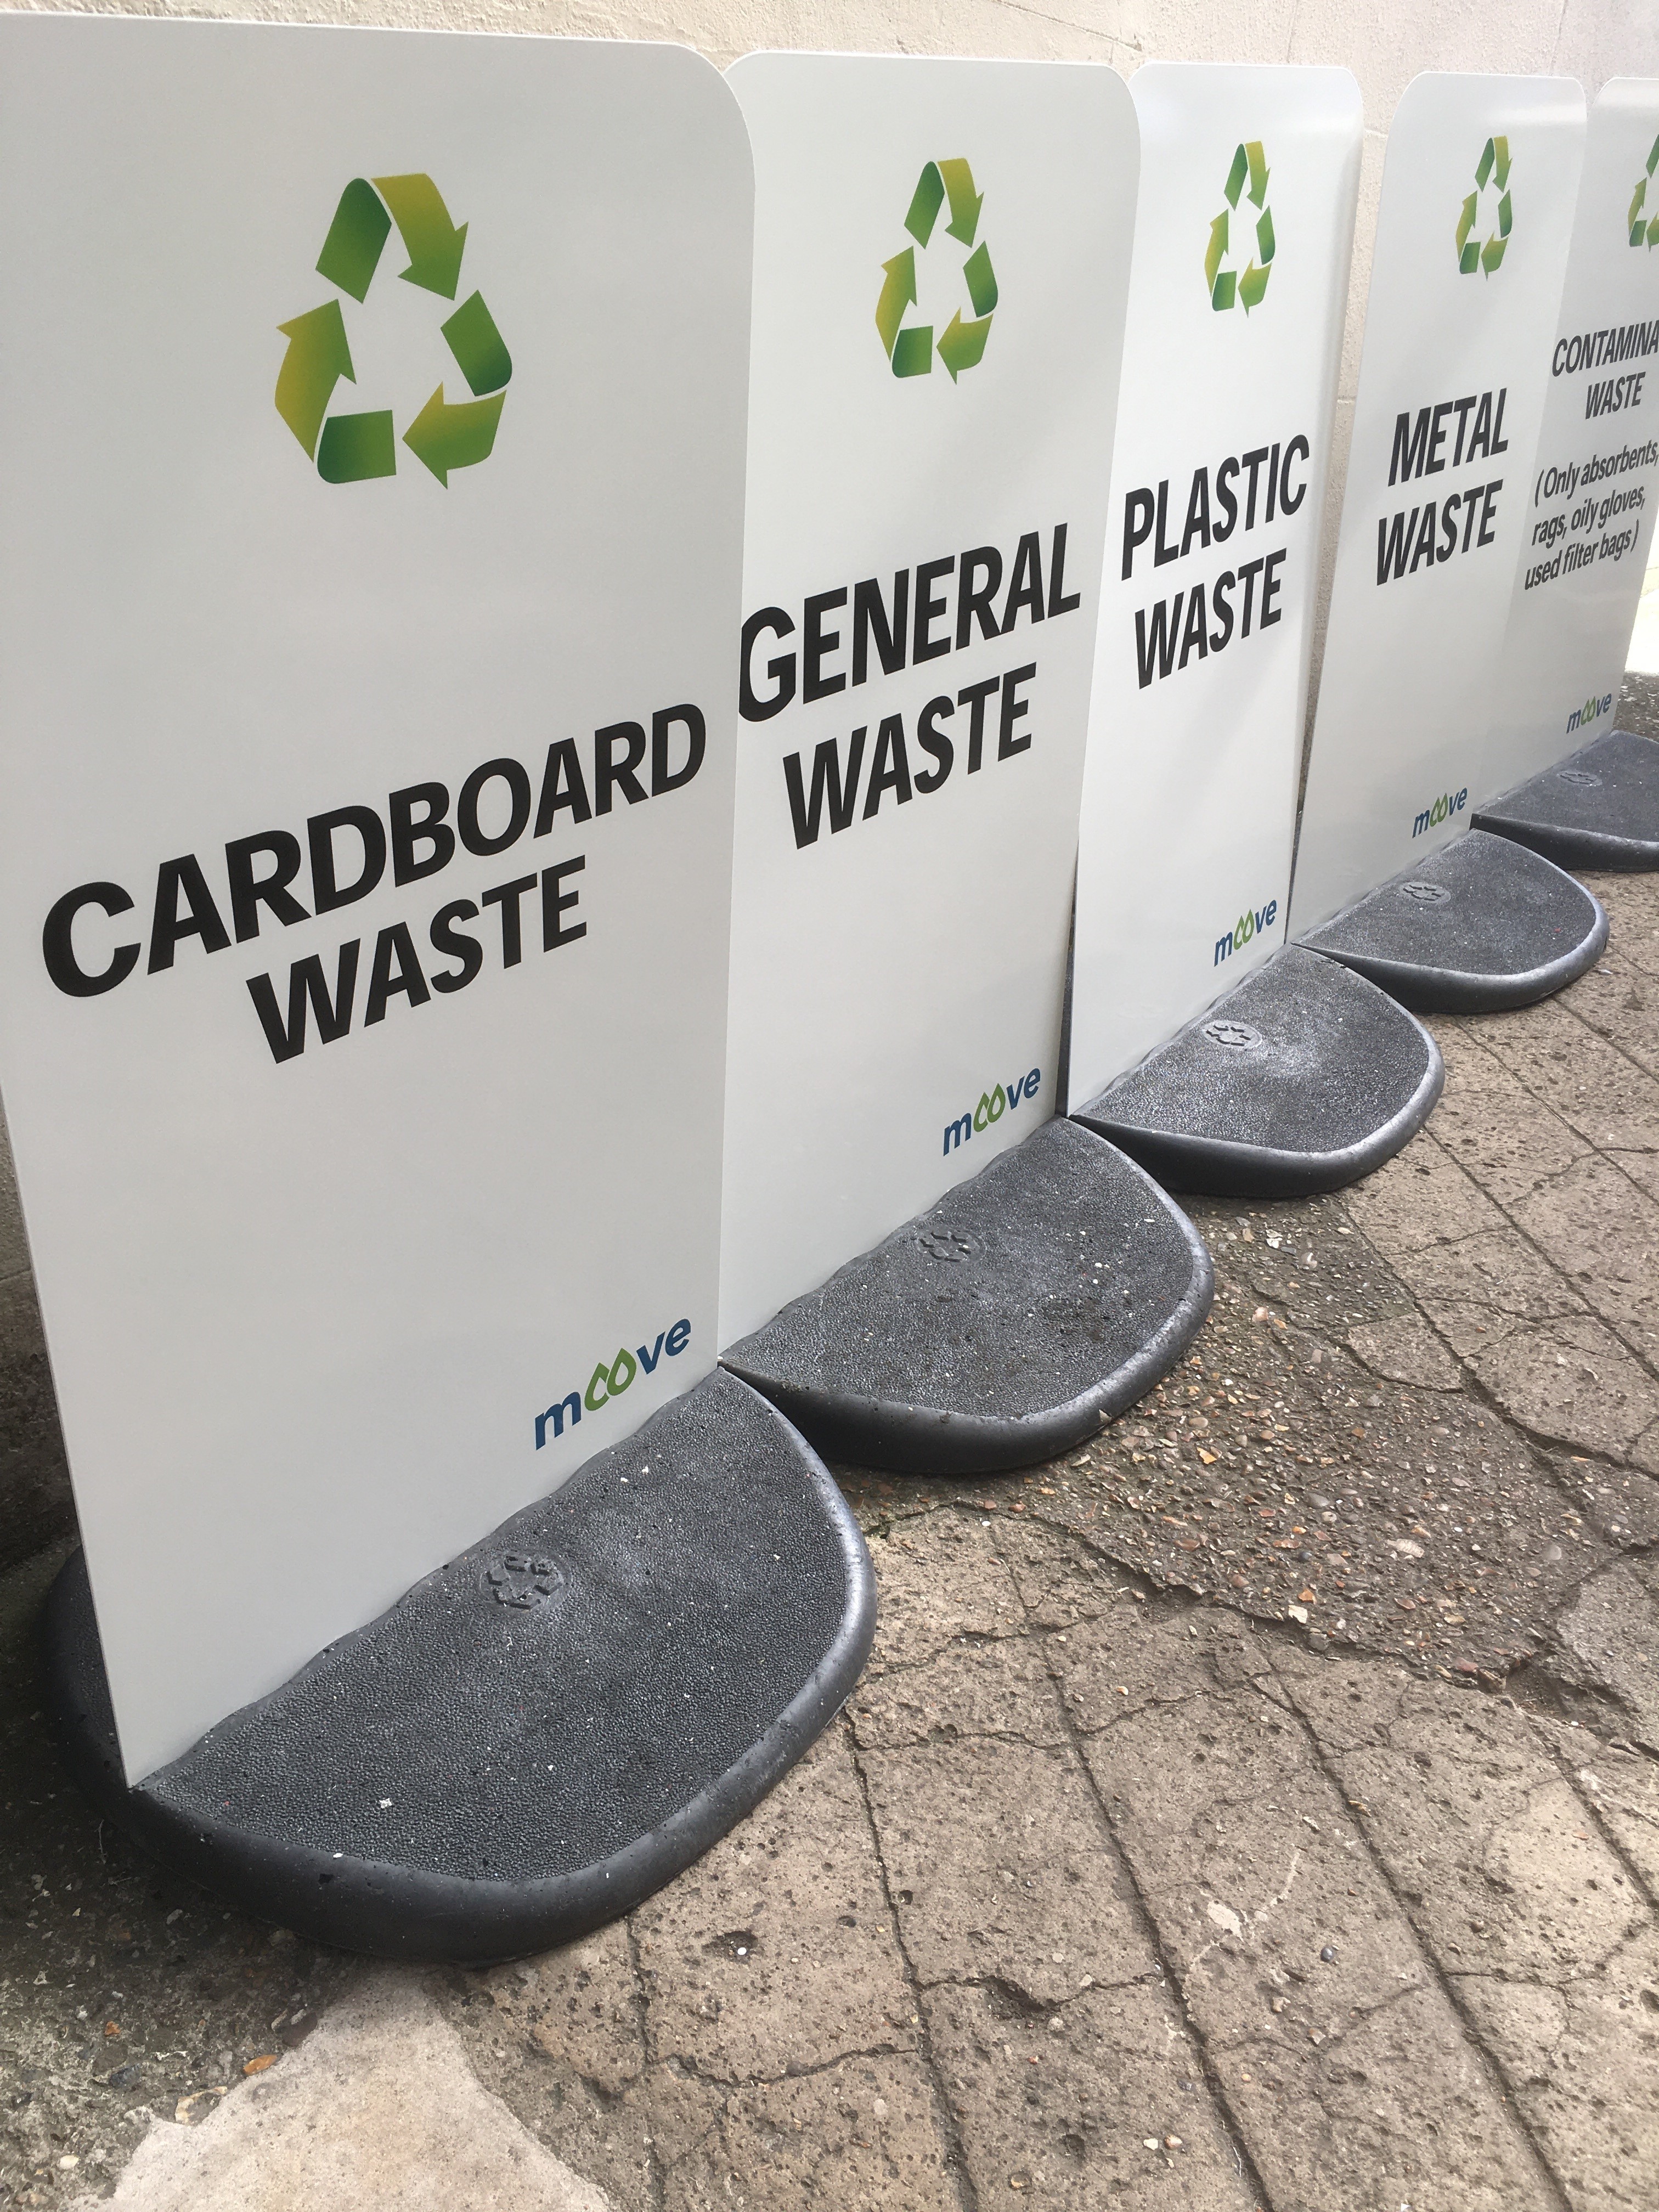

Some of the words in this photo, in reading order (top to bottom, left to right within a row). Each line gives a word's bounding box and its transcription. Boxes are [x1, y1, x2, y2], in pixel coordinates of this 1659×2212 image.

[1552, 320, 1659, 377] CONTAMINA
[1388, 388, 1508, 487] METAL
[1585, 371, 1646, 420] WASTE
[1121, 435, 1310, 581] PLASTIC
[1581, 439, 1659, 486] absorbents,
[1377, 479, 1503, 586] WASTE
[1532, 514, 1567, 549] rags,
[1571, 497, 1599, 534] oily
[1598, 486, 1645, 529] gloves,
[1525, 549, 1562, 590] used
[1562, 543, 1599, 574] filter
[738, 522, 1081, 722] GENERAL
[1135, 548, 1287, 690] WASTE
[783, 662, 1037, 849] WASTE
[1566, 692, 1612, 733] moove
[42, 703, 706, 997] CARDBOARD
[1412, 787, 1468, 838] moove
[246, 855, 587, 1064] WASTE
[1214, 900, 1277, 967] moove
[943, 1068, 1040, 1156] moove
[534, 1318, 691, 1451] moove
